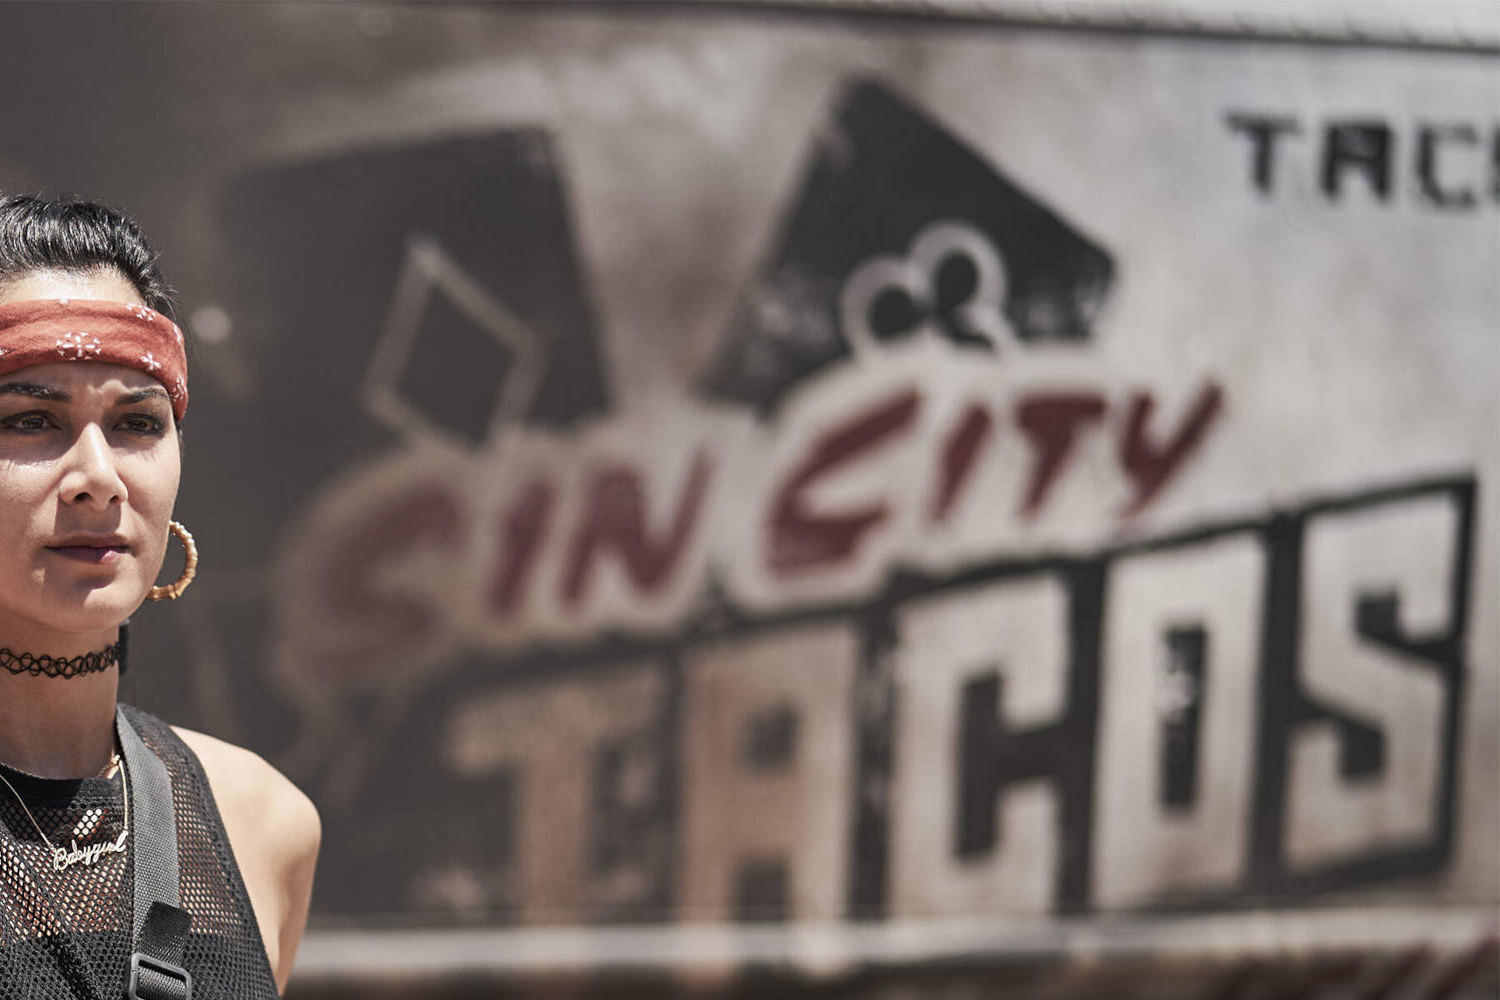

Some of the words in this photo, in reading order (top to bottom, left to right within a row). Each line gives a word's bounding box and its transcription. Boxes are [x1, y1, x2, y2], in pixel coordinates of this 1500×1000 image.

[1222, 108, 1500, 213] TAC
[315, 450, 712, 685] SIN
[762, 382, 1224, 578] CITY
[444, 490, 1452, 928] TACOS
